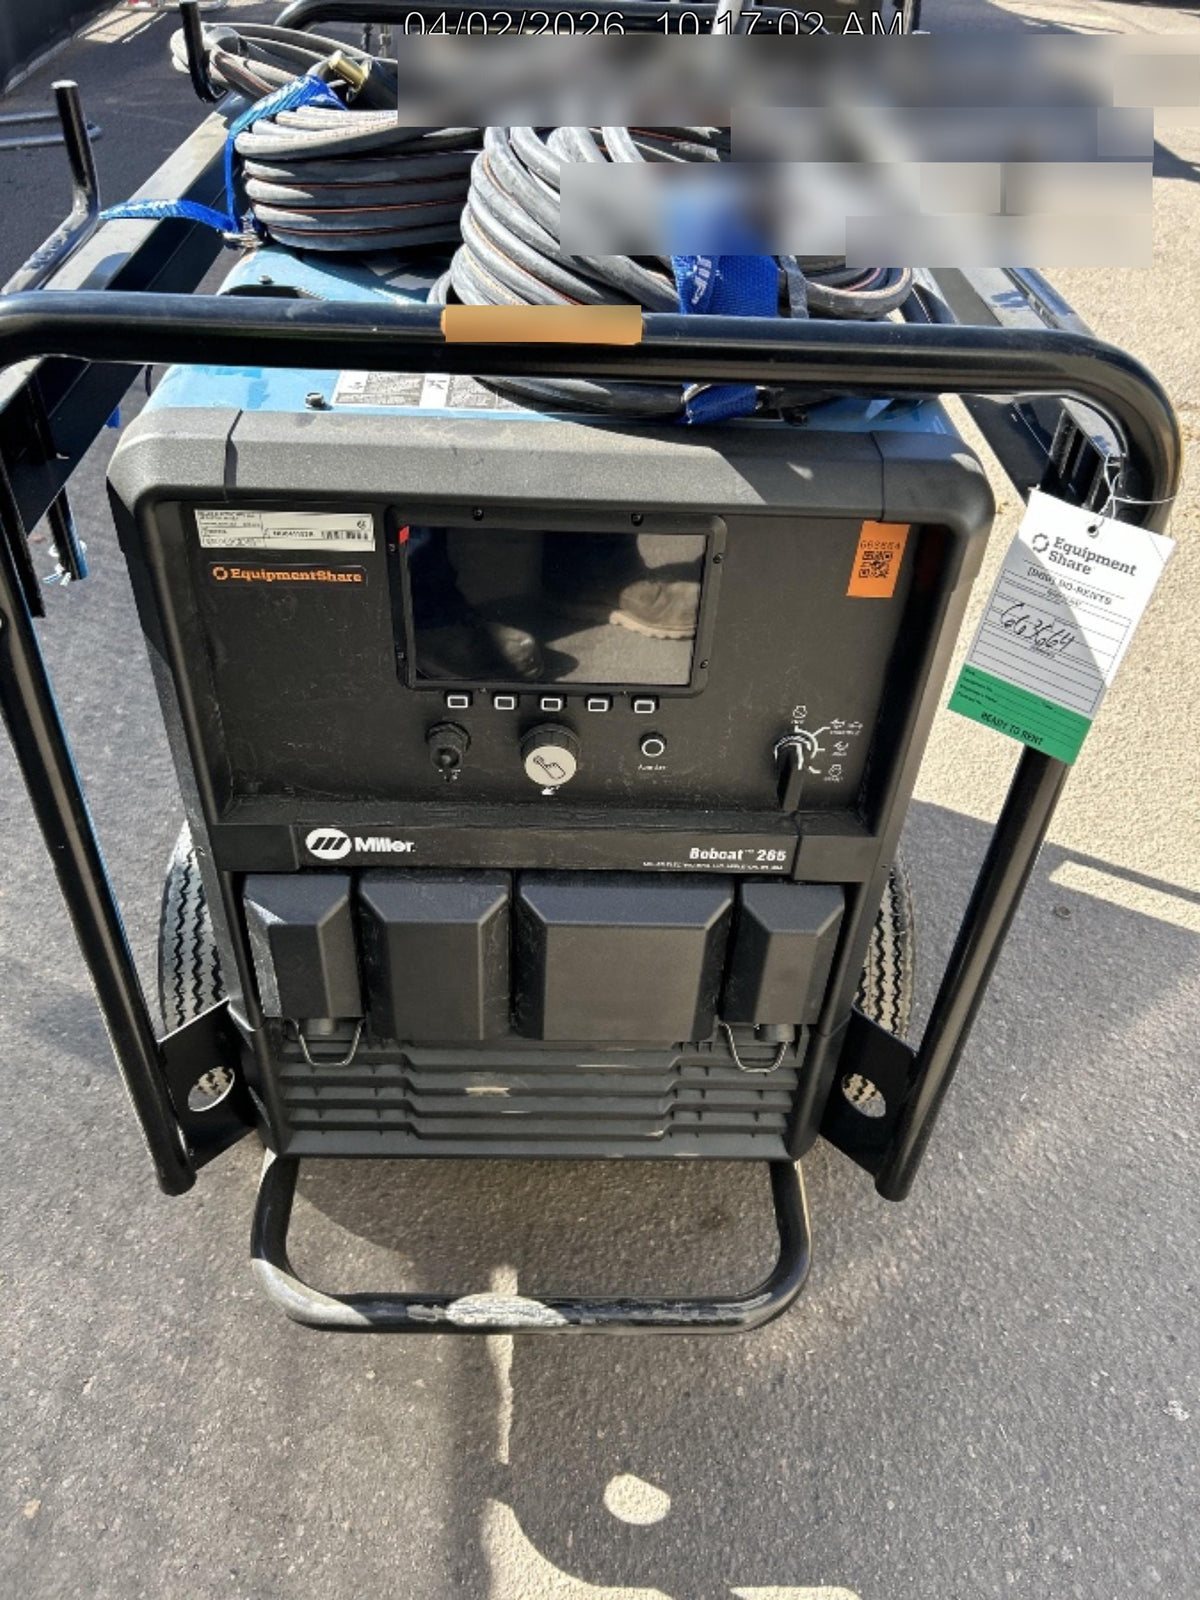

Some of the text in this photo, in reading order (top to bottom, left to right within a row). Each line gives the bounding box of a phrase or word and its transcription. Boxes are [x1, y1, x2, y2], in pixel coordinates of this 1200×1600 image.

[1048, 550, 1093, 575] Share
[1053, 536, 1137, 577] Equipment
[229, 568, 363, 583] EquipmentShare
[980, 711, 1044, 746] READY TO RENT
[756, 849, 787, 862] 265
